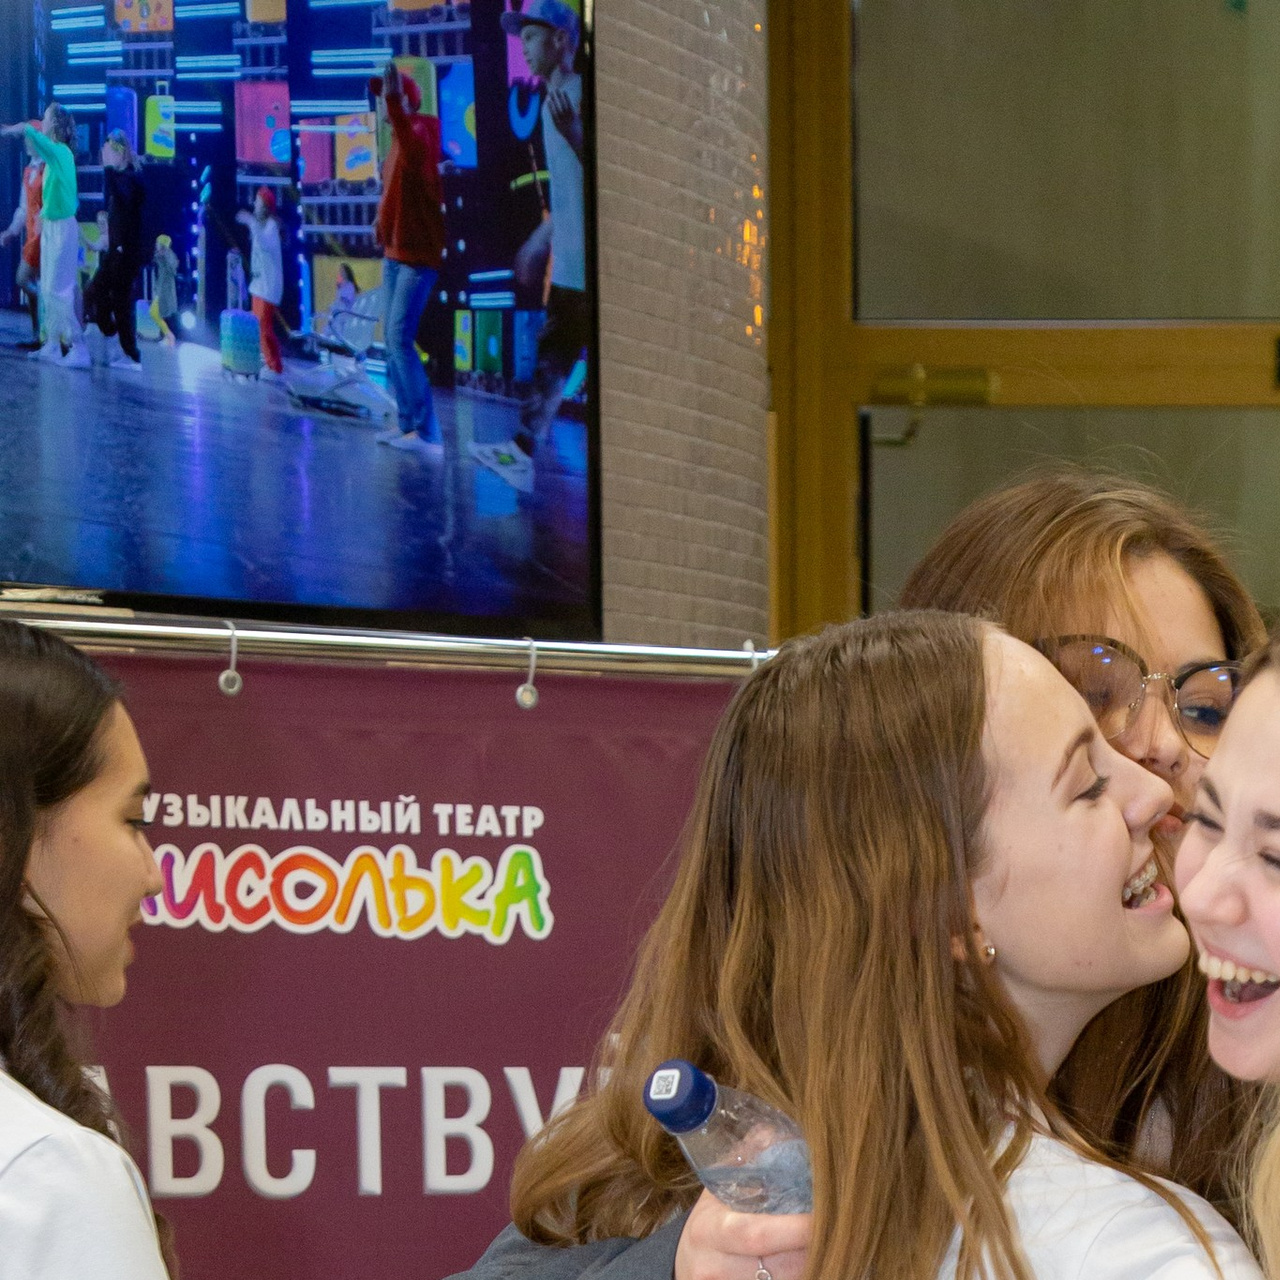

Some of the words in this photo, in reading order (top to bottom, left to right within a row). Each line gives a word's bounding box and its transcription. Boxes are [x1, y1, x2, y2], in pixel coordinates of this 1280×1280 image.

[432, 803, 546, 838] ТЕАТР
[141, 843, 553, 943] ИСОЛЬКА
[82, 1063, 606, 1199] ВСТВУ
